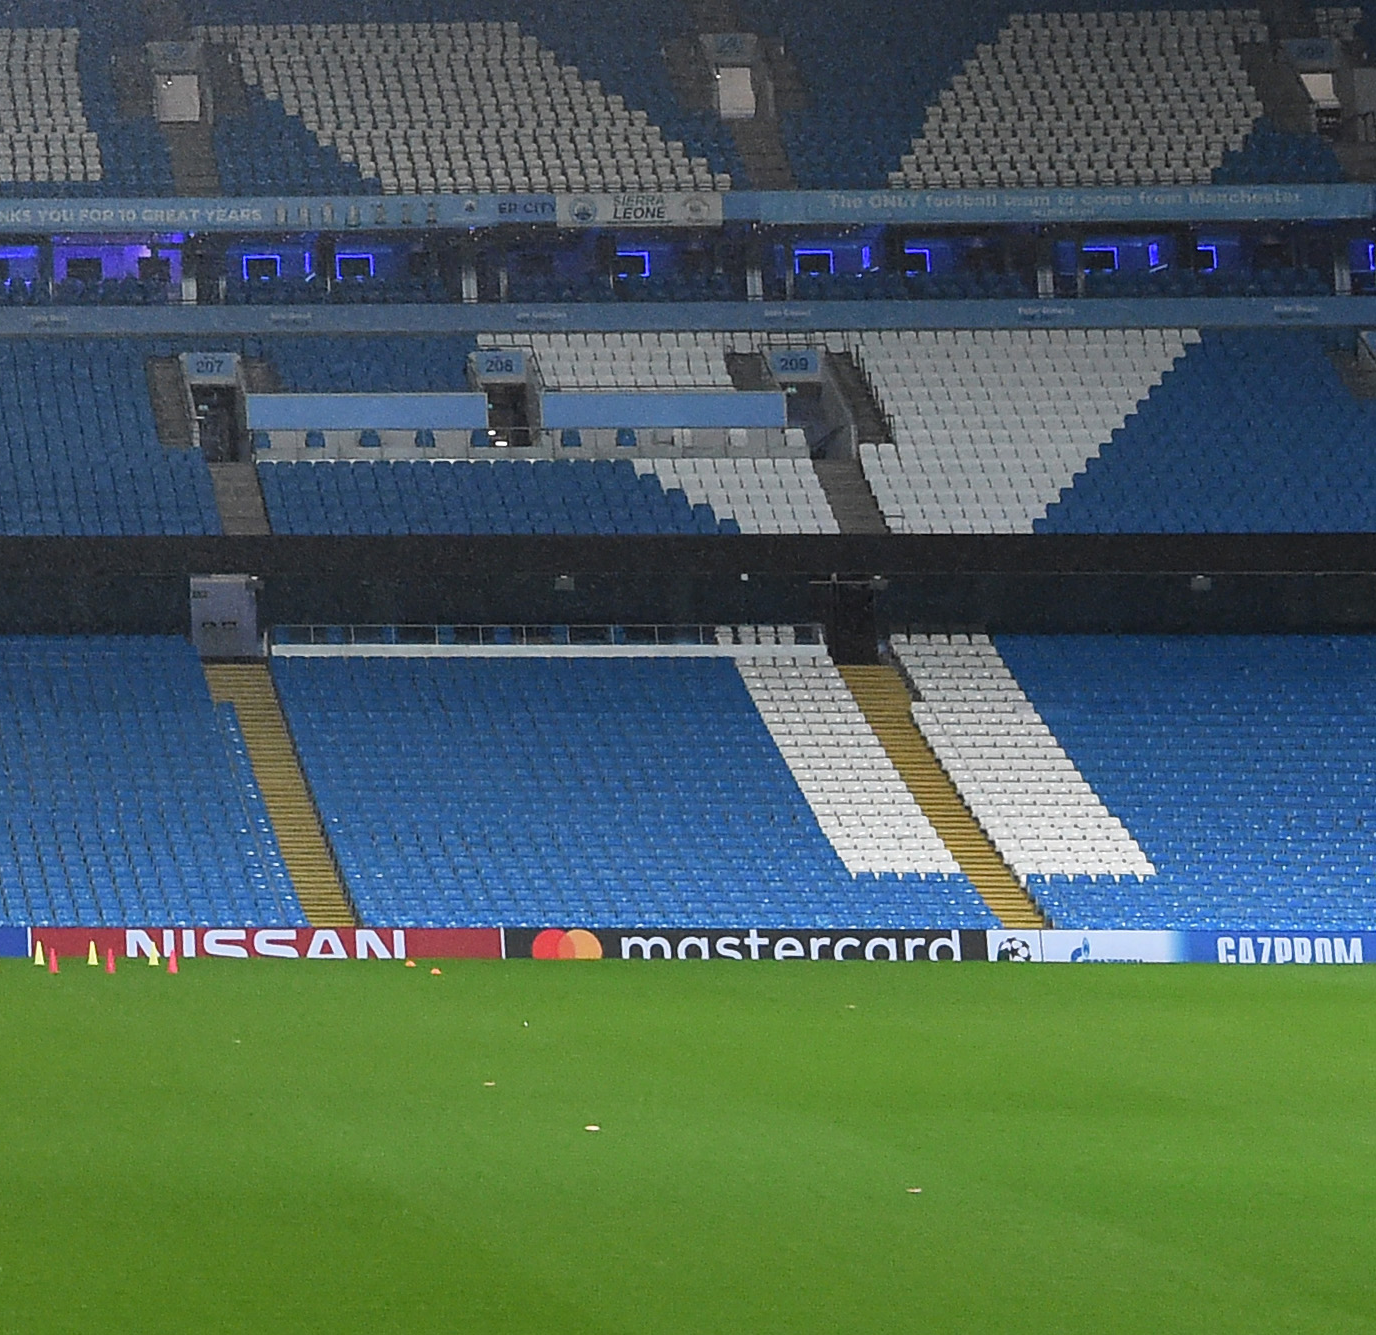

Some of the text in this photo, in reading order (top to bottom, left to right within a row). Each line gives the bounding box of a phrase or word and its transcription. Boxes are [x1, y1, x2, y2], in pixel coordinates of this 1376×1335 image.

[611, 194, 666, 207] SIERRA
[37, 208, 74, 222] YOU
[80, 208, 113, 222] FOR
[117, 208, 136, 222] 10
[141, 208, 200, 222] GREAT
[205, 208, 262, 222] YEARS
[612, 206, 666, 220] LEONE
[195, 360, 224, 375] 207
[779, 357, 809, 371] 209
[125, 929, 406, 959] NISSAN
[620, 929, 962, 962] mastercard
[1215, 937, 1364, 964] GAZPROM
